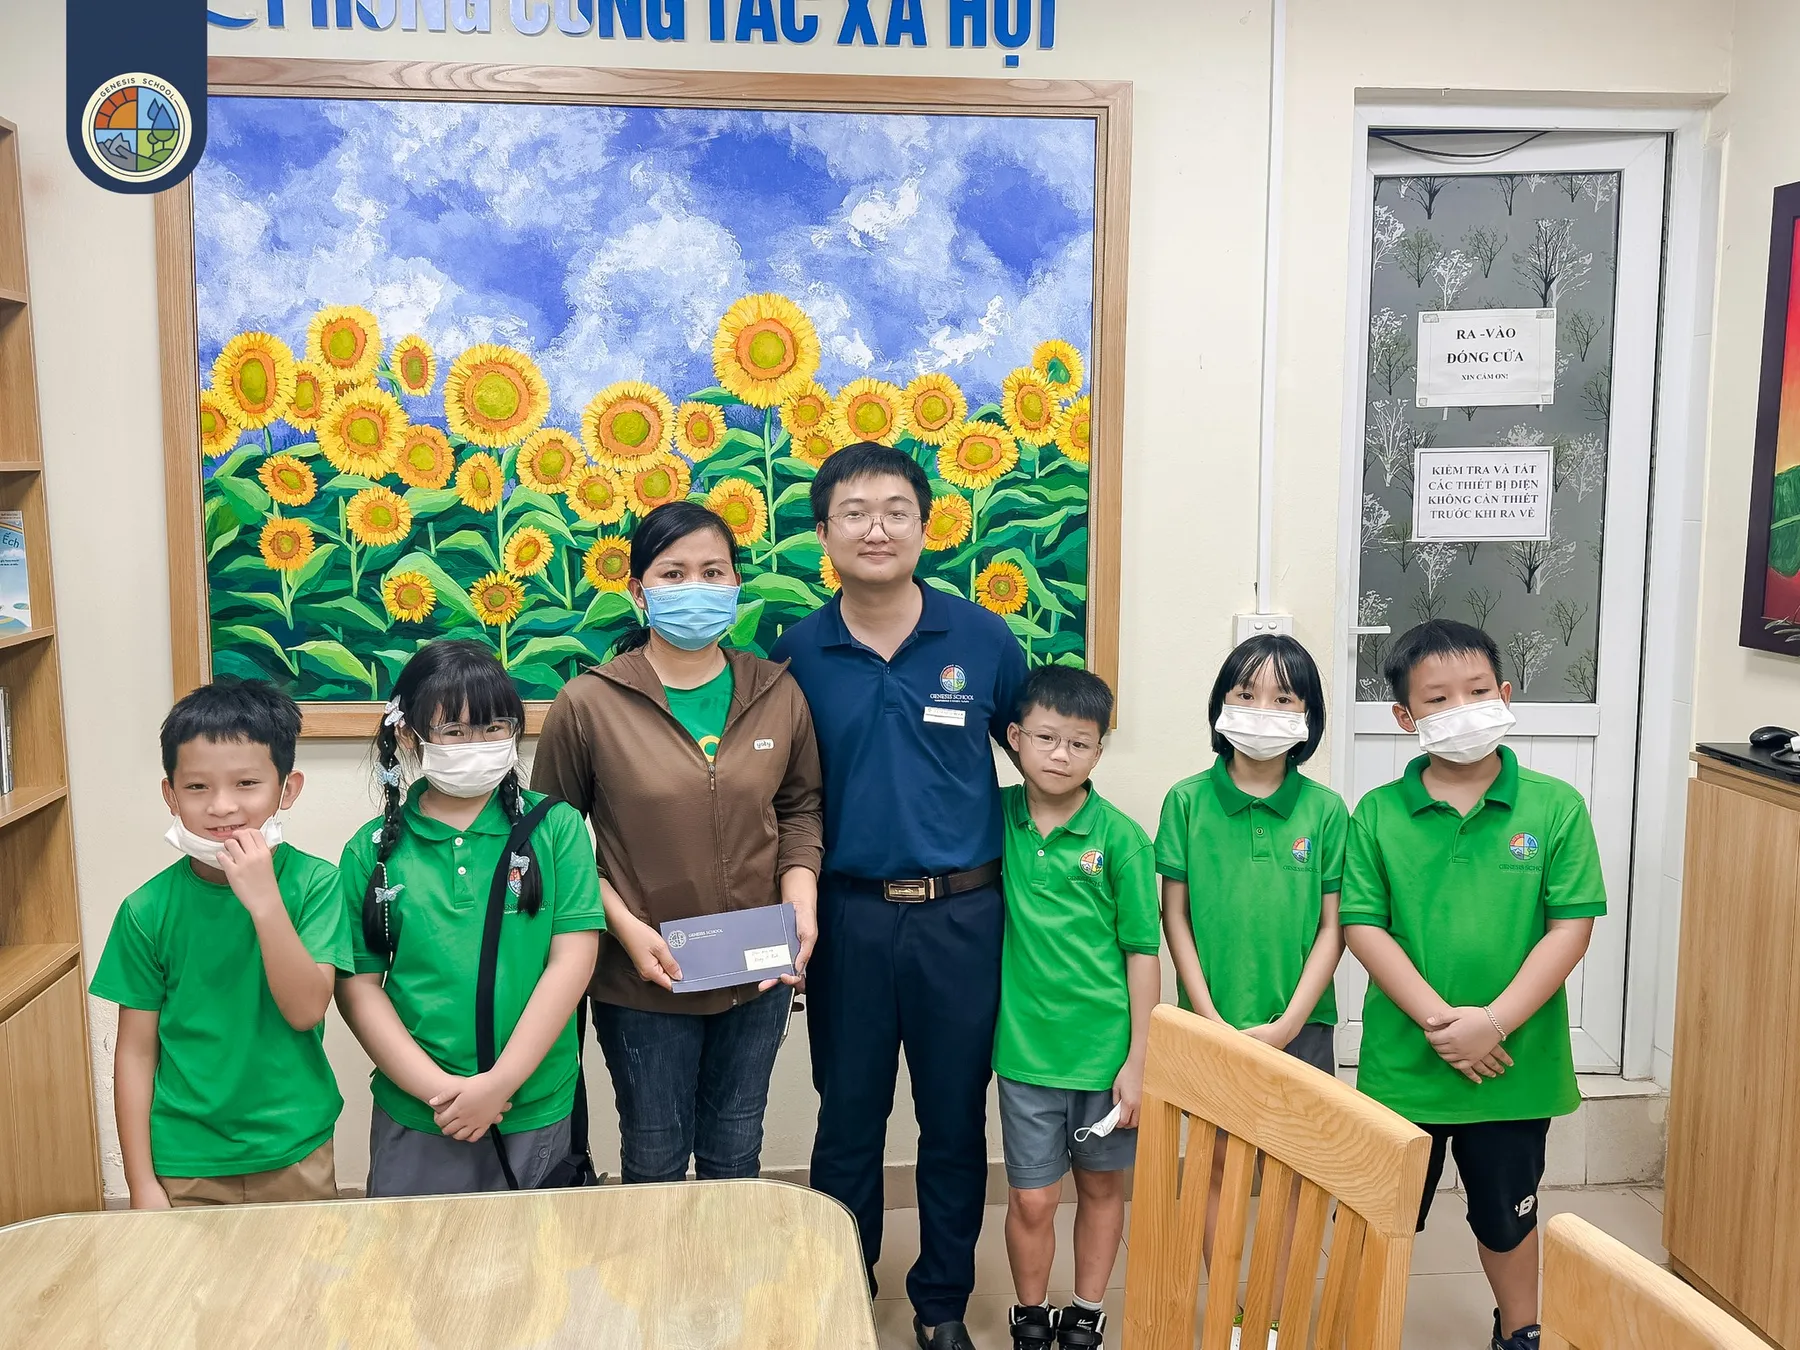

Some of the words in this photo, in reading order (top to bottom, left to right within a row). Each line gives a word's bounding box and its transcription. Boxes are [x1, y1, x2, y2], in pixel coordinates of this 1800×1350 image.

[1456, 329, 1476, 340] RA
[1493, 348, 1524, 362] CỬA
[1466, 465, 1490, 475] TRA
[1494, 463, 1510, 474] VÀ
[1428, 479, 1453, 490] CÁC
[1495, 480, 1507, 491] BỊ
[1428, 493, 1471, 505] KHÔNG
[1475, 509, 1496, 519] KHI
[1500, 509, 1516, 518] RA
